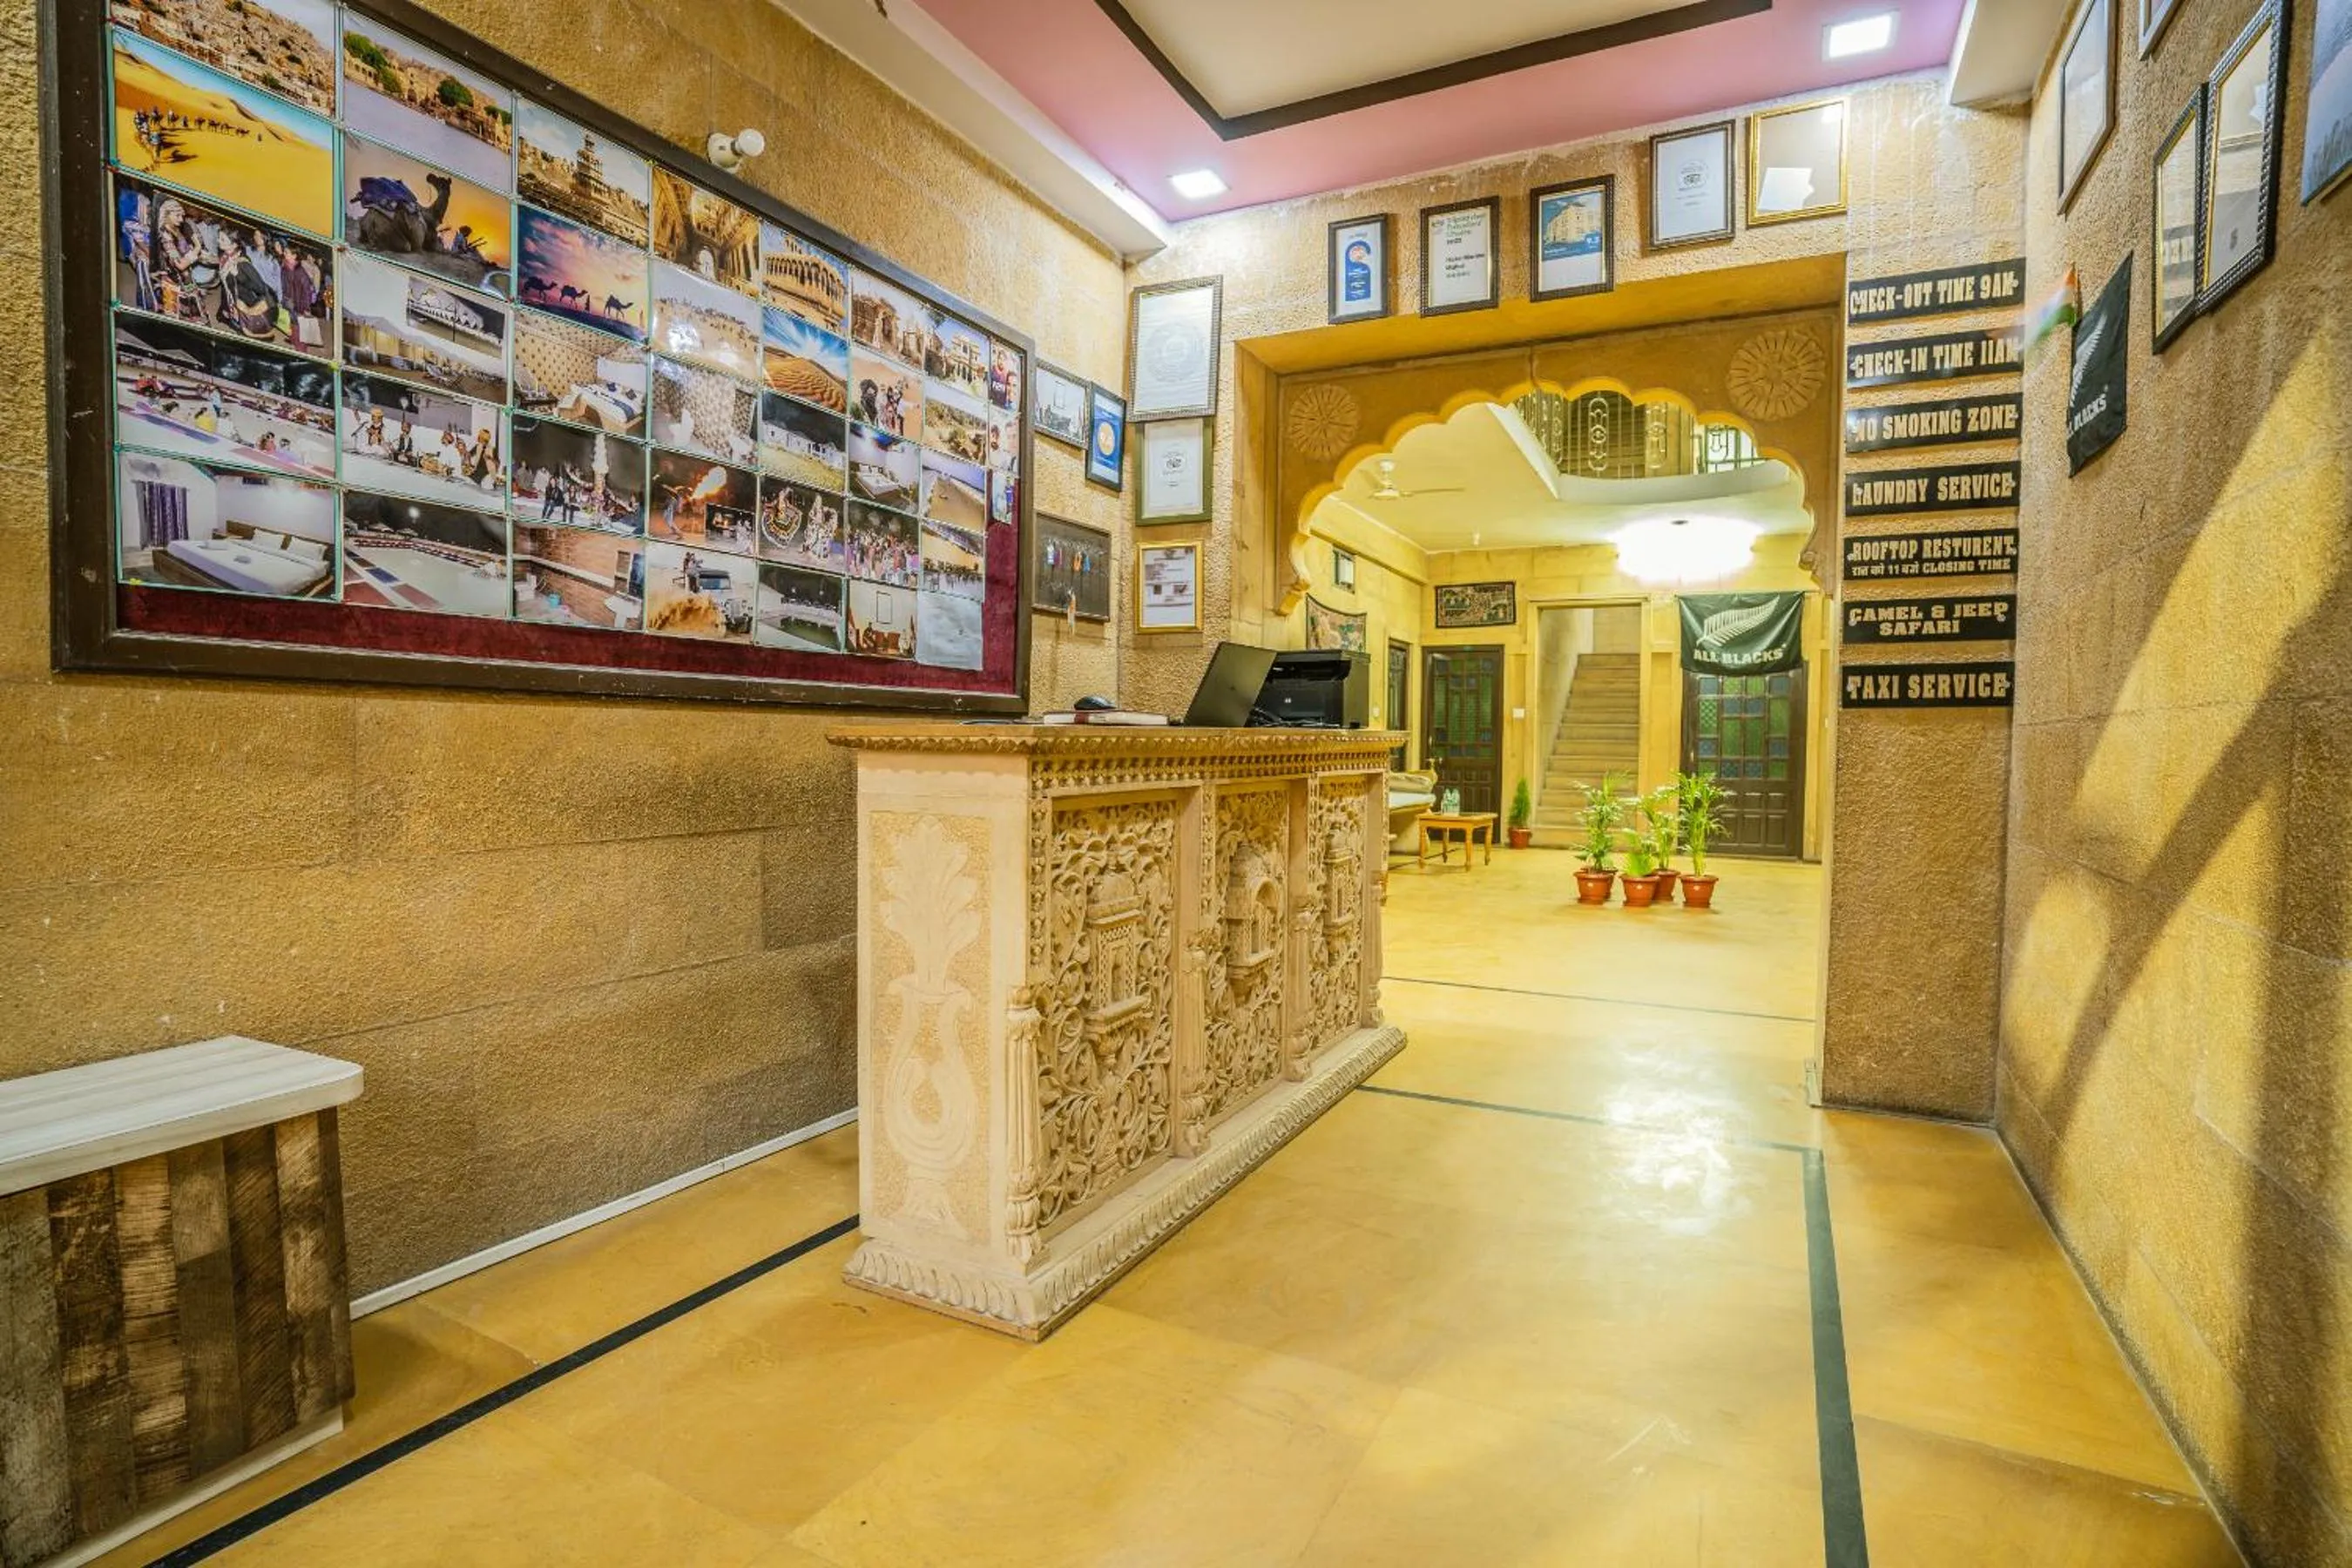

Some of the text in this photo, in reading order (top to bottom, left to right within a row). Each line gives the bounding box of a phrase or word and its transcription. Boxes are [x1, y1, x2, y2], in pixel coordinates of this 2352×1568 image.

[1849, 271, 2017, 314] CHECK-OUT TIME 9AM
[1854, 347, 1928, 378] CHECK-IN
[1932, 341, 1975, 370] TIME
[1855, 404, 2017, 443] NO SMOKING ZONE
[1852, 472, 2012, 506] LAUNDRY SERVICE
[1852, 539, 1918, 562] ROOFTOP
[1922, 560, 1975, 574] CLOSING
[1977, 558, 2011, 571] TIME
[1849, 605, 1923, 623] CAMEL
[1953, 601, 2009, 618] JEEP
[1879, 619, 1961, 636] SAFARI
[1693, 648, 1783, 664] ALL BLACKS
[1848, 672, 2007, 700] TAXI SERVICE
